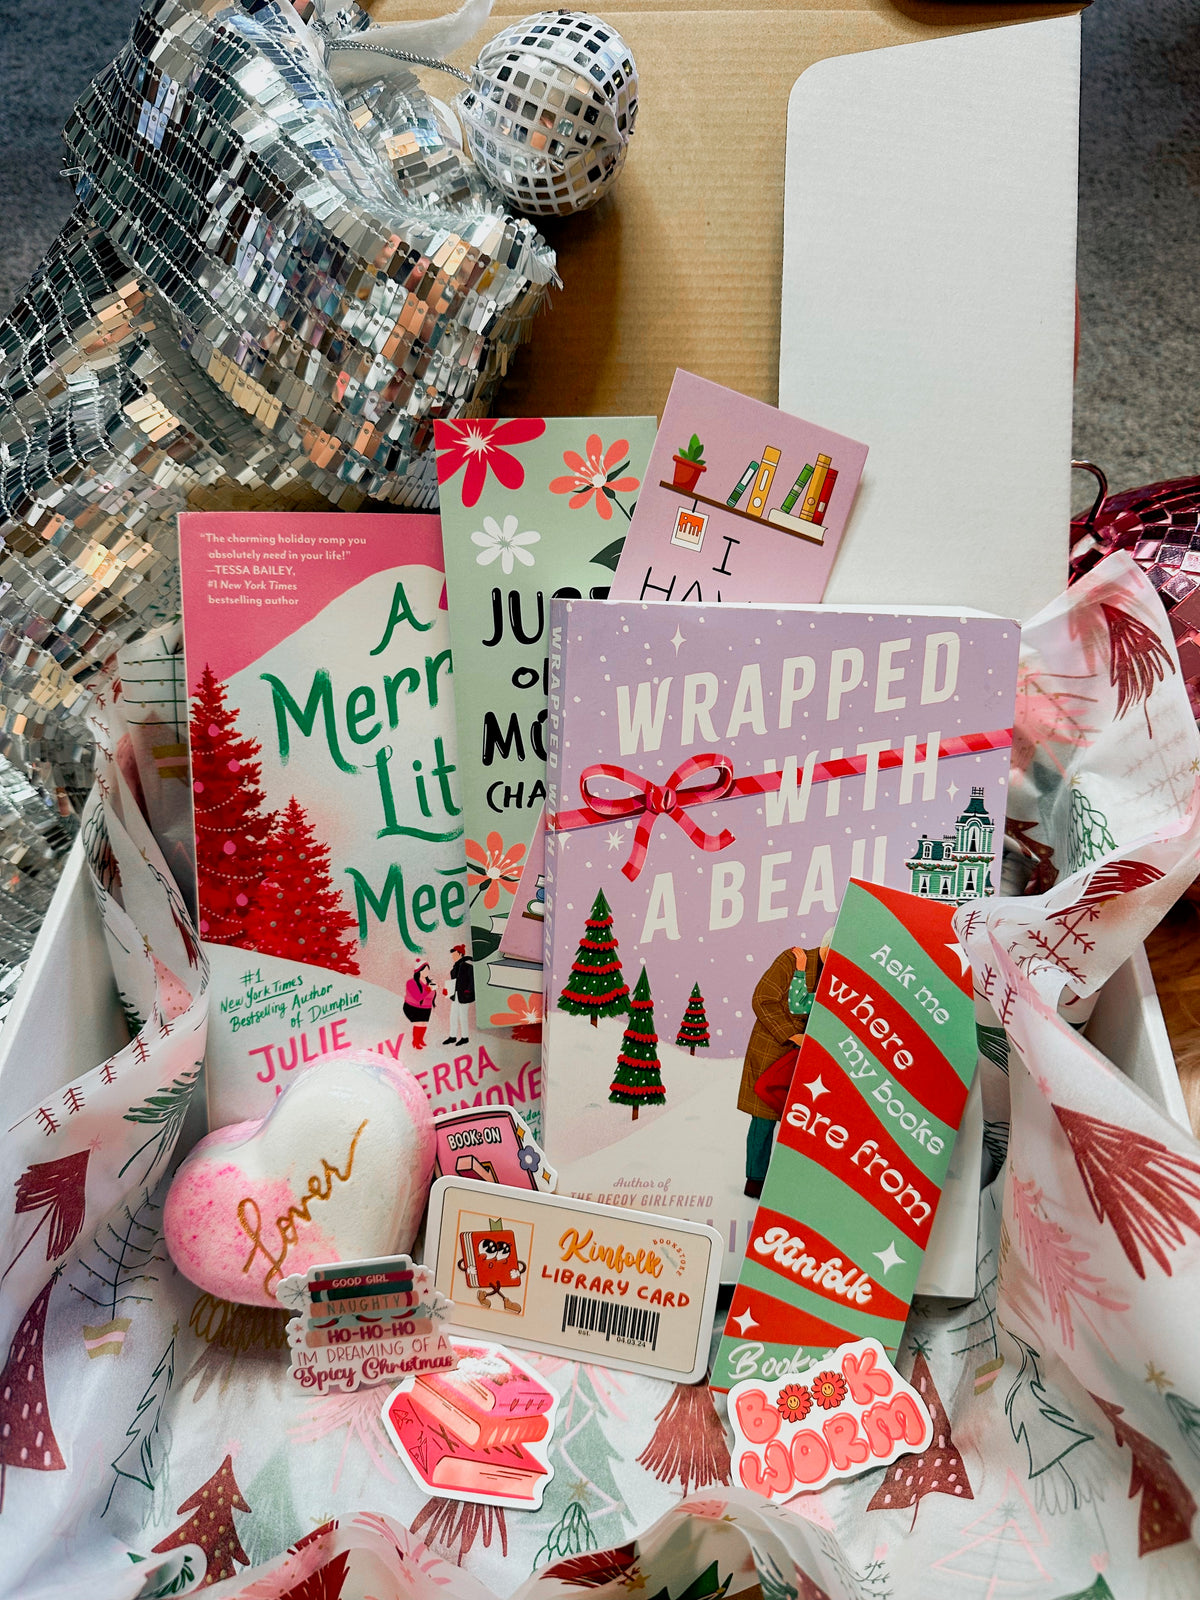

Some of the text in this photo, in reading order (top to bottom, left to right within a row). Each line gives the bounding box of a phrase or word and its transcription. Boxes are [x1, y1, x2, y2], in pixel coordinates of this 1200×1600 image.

[208, 549, 261, 562] absolutely
[263, 550, 287, 560] need
[288, 550, 298, 560] in
[301, 551, 324, 562] your
[227, 533, 276, 546] charming
[278, 534, 316, 546] holiday
[318, 536, 346, 547] romp
[347, 537, 367, 547] you
[712, 535, 741, 576] I
[207, 580, 298, 591] #1 New York Times
[208, 595, 299, 606] bestselling author
[370, 582, 436, 656] A
[259, 649, 454, 774] Merr
[549, 626, 562, 769] WRAPPED
[616, 631, 960, 756] WRAPPED
[763, 731, 942, 828] WITH
[547, 783, 558, 856] WITH
[640, 872, 681, 944] A
[220, 975, 304, 1014] New York Times
[239, 968, 264, 987] #1
[869, 943, 950, 1025] Ask me
[229, 984, 333, 1032] Bestselling Author
[290, 1010, 303, 1028] of
[828, 974, 914, 1071] where
[248, 1018, 352, 1083] JULIE
[838, 1034, 945, 1156] my books
[484, 1127, 502, 1144] ON
[612, 1177, 672, 1192] Author of
[786, 1102, 933, 1227] are from
[597, 1193, 637, 1207] DECOY
[640, 1194, 713, 1208] GIRLFRIEND
[558, 1227, 664, 1279] Kinfolk
[753, 1226, 874, 1305] Kinfolk
[332, 1273, 390, 1289] GOOD GIRL
[541, 1264, 690, 1308] LIBRARY CARD
[327, 1296, 400, 1316] NAUGHTY
[327, 1320, 416, 1344] HO-HO-HO
[327, 1340, 404, 1364] DREAMING
[412, 1336, 430, 1353] OF
[437, 1335, 448, 1350] A
[578, 1329, 647, 1348] est. 04.03.24
[293, 1354, 454, 1391] Spicy Christmas
[739, 1391, 927, 1499] WORM
